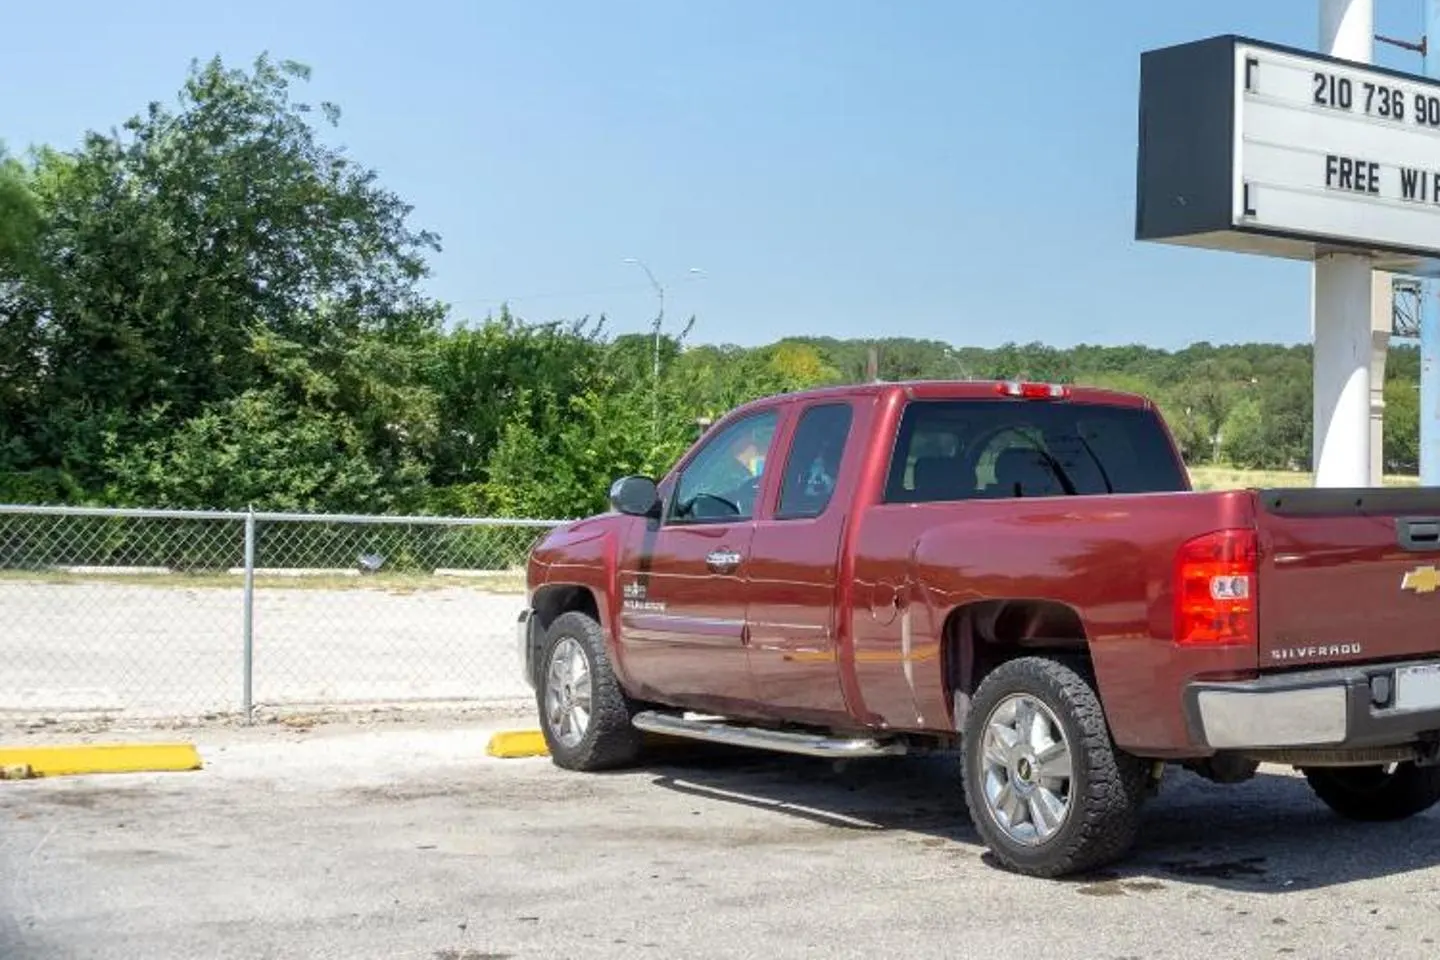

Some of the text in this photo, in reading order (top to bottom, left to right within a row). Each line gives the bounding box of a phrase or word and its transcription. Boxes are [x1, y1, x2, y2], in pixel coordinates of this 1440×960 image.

[1313, 72, 1351, 108] 210
[1364, 82, 1404, 120] 736
[1325, 155, 1380, 193] FREE
[1271, 643, 1361, 659] SILVERADO
